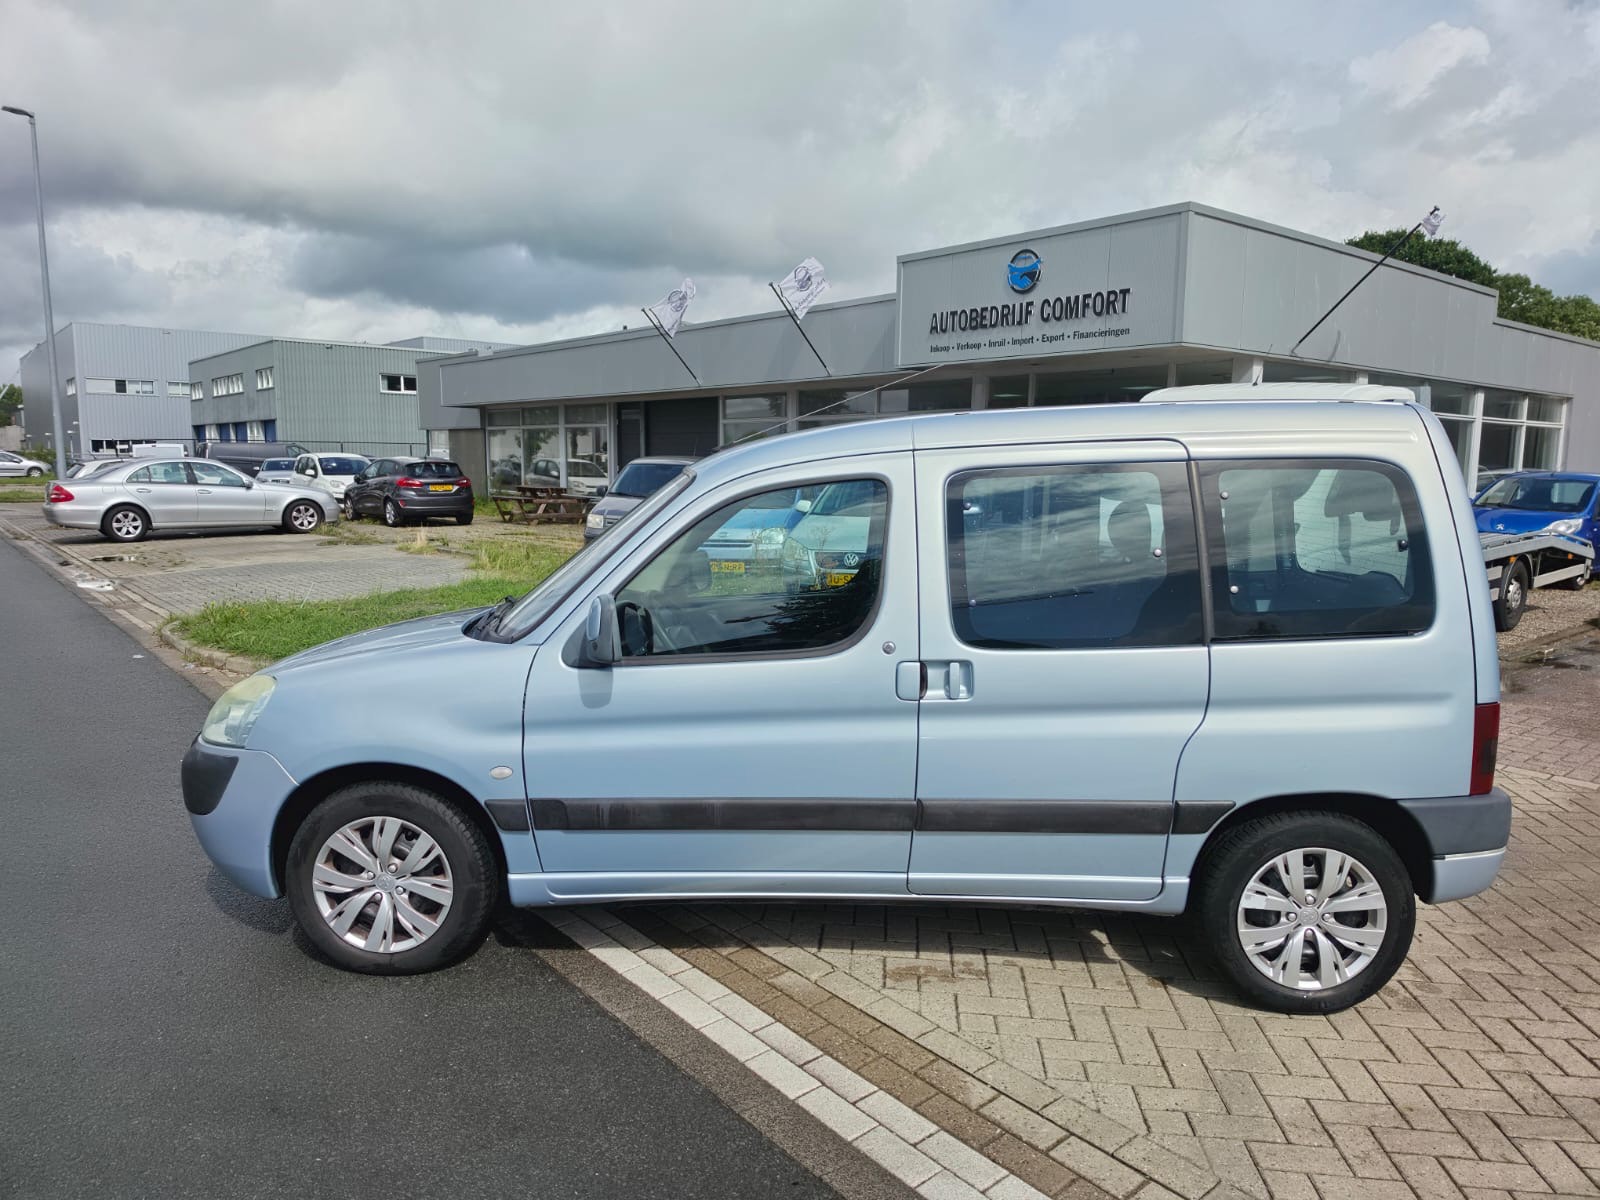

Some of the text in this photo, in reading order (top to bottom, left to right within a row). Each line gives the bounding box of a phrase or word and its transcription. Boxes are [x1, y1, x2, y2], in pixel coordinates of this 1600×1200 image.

[929, 288, 1131, 335] AUTOBEDRIJF COMFORT
[930, 327, 1130, 353] Inkoop Verkoop Inruil Import Export Financieringen
